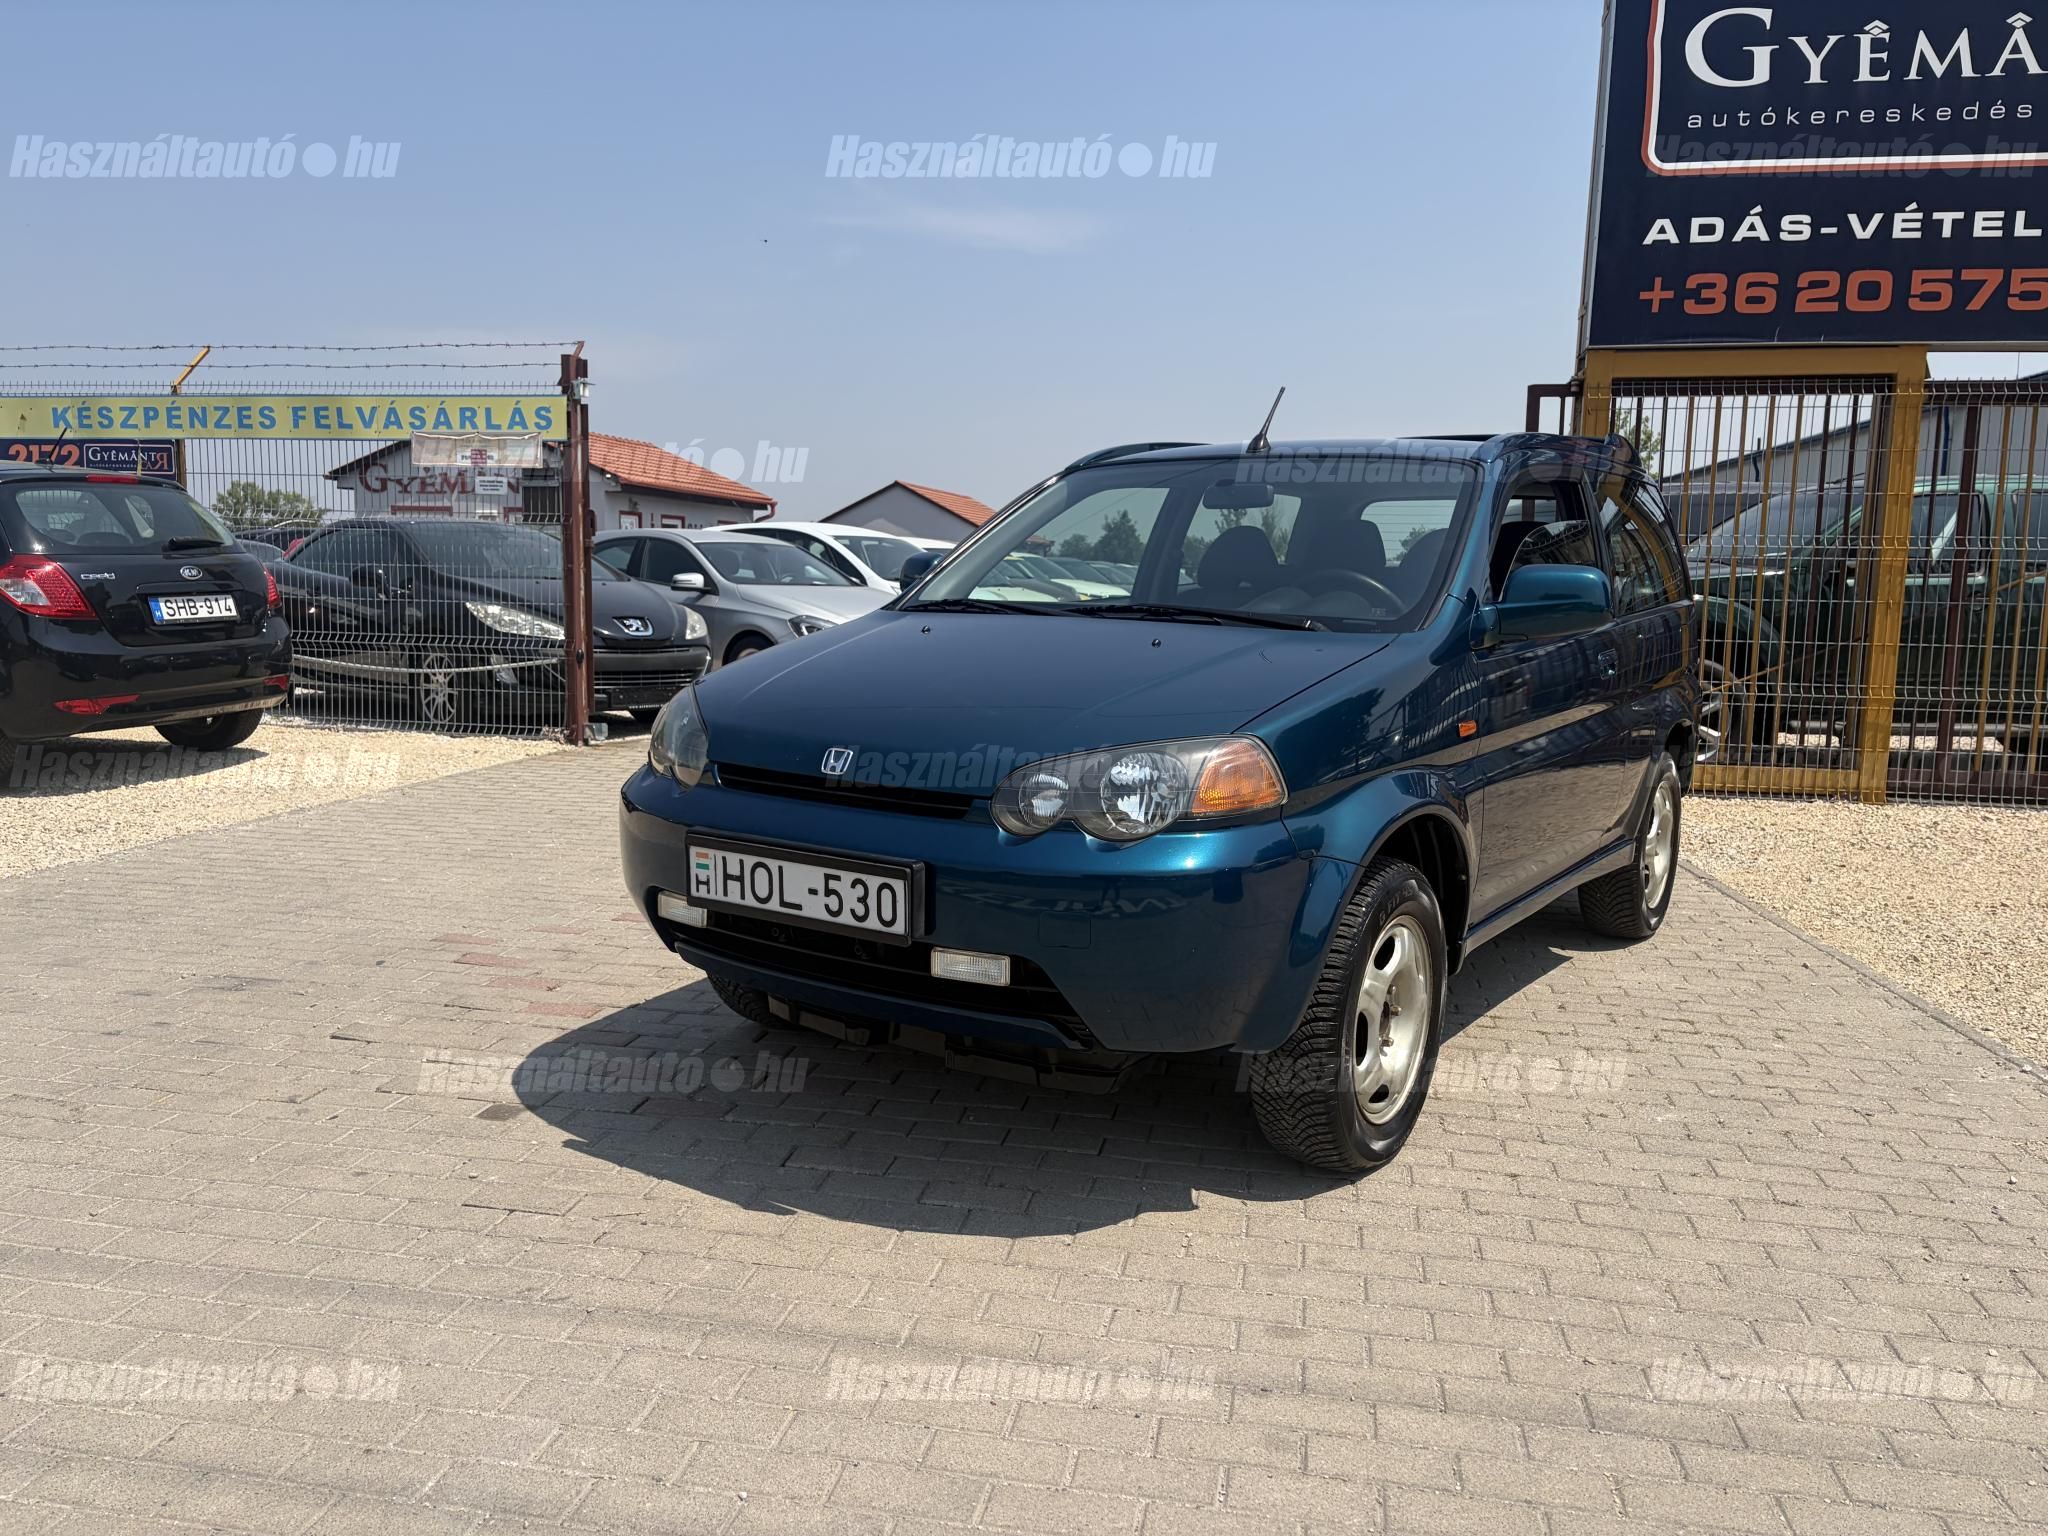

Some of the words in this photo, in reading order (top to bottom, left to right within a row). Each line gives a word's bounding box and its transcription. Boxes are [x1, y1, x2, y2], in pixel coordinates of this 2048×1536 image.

[1688, 100, 2033, 128] autókereskedés
[1642, 202, 2043, 246] ADÁS-VÉTEL
[1639, 273, 1779, 316] +36
[1795, 270, 1893, 313] 20
[1908, 268, 2048, 311] 575
[52, 401, 277, 430] KÉSZPÉNZES
[292, 400, 553, 431] FELVÁSÁRLÁS
[164, 597, 232, 617] SHB-914
[722, 856, 897, 928] HOL-530
